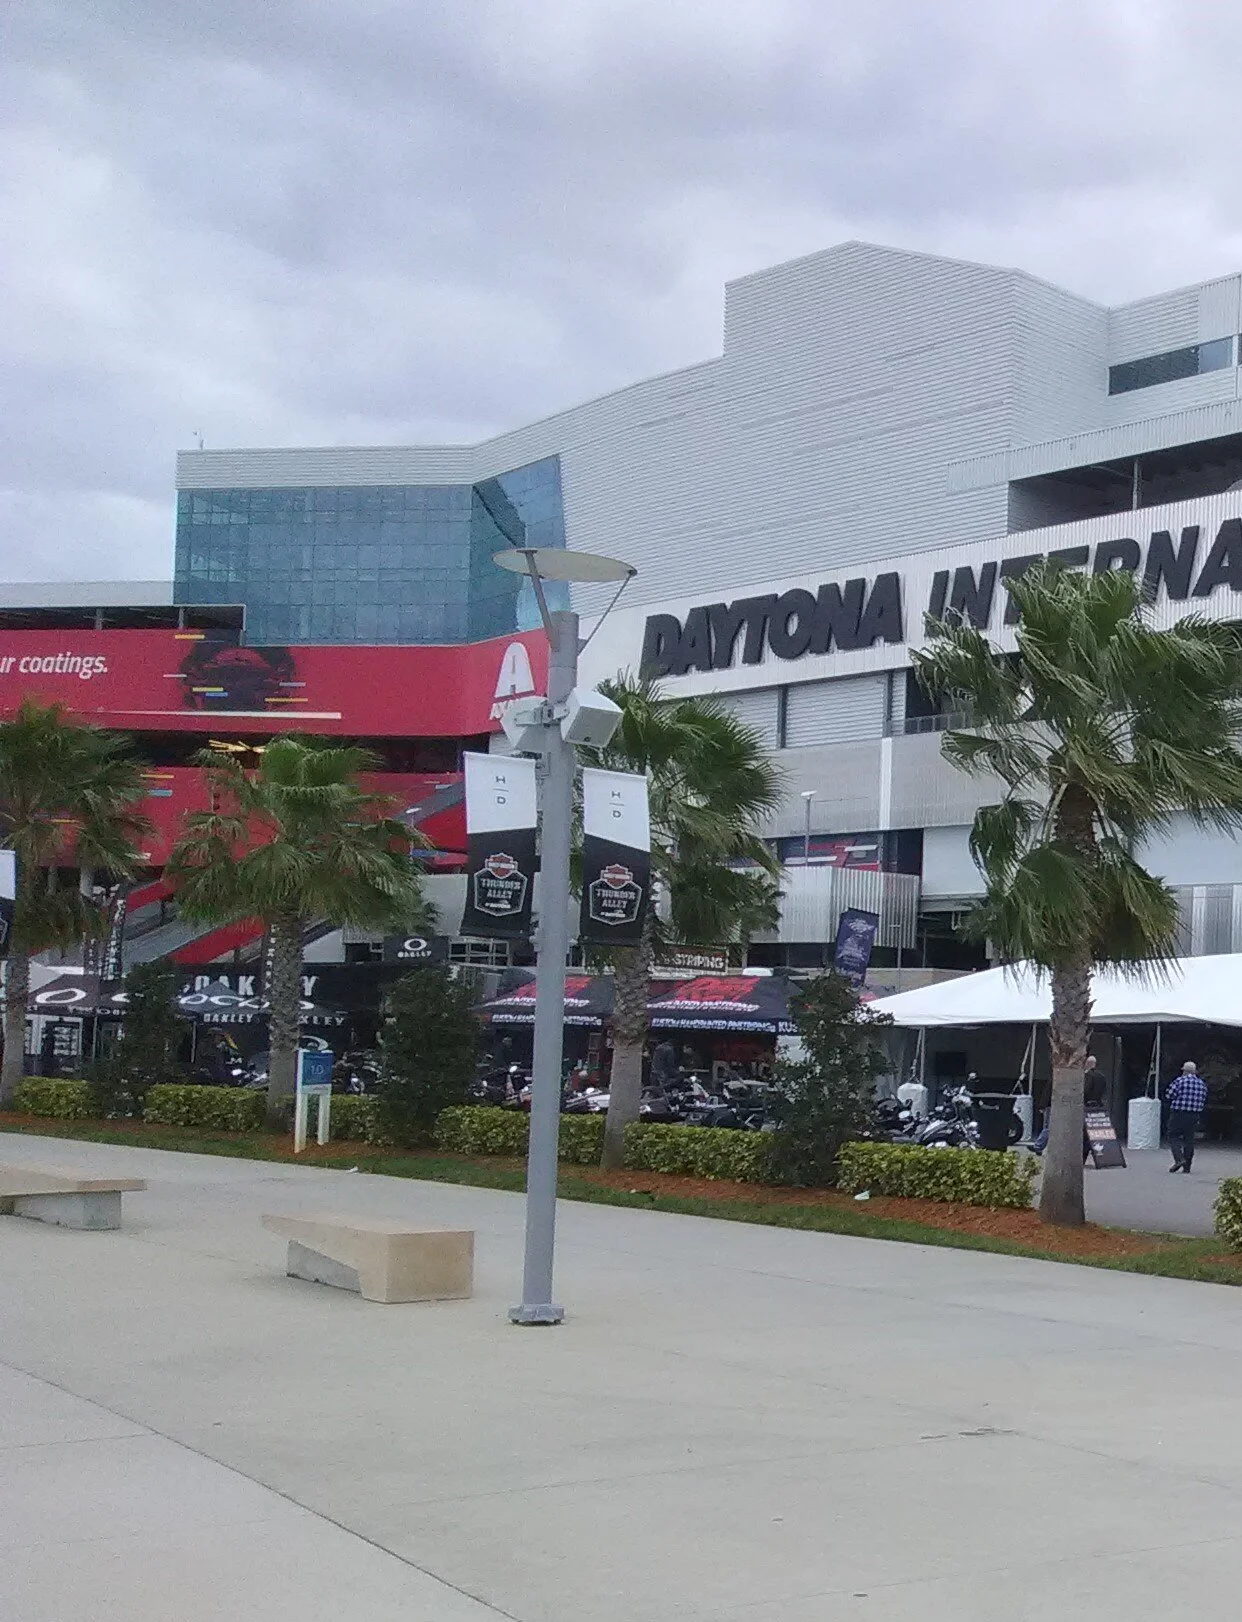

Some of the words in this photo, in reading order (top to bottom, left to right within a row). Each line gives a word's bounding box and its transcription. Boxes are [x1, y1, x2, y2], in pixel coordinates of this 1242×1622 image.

[639, 571, 903, 680] DAYTONA
[20, 651, 108, 680] coatings.
[601, 899, 628, 909] ALLEY
[203, 1012, 253, 1023] OAKLEY
